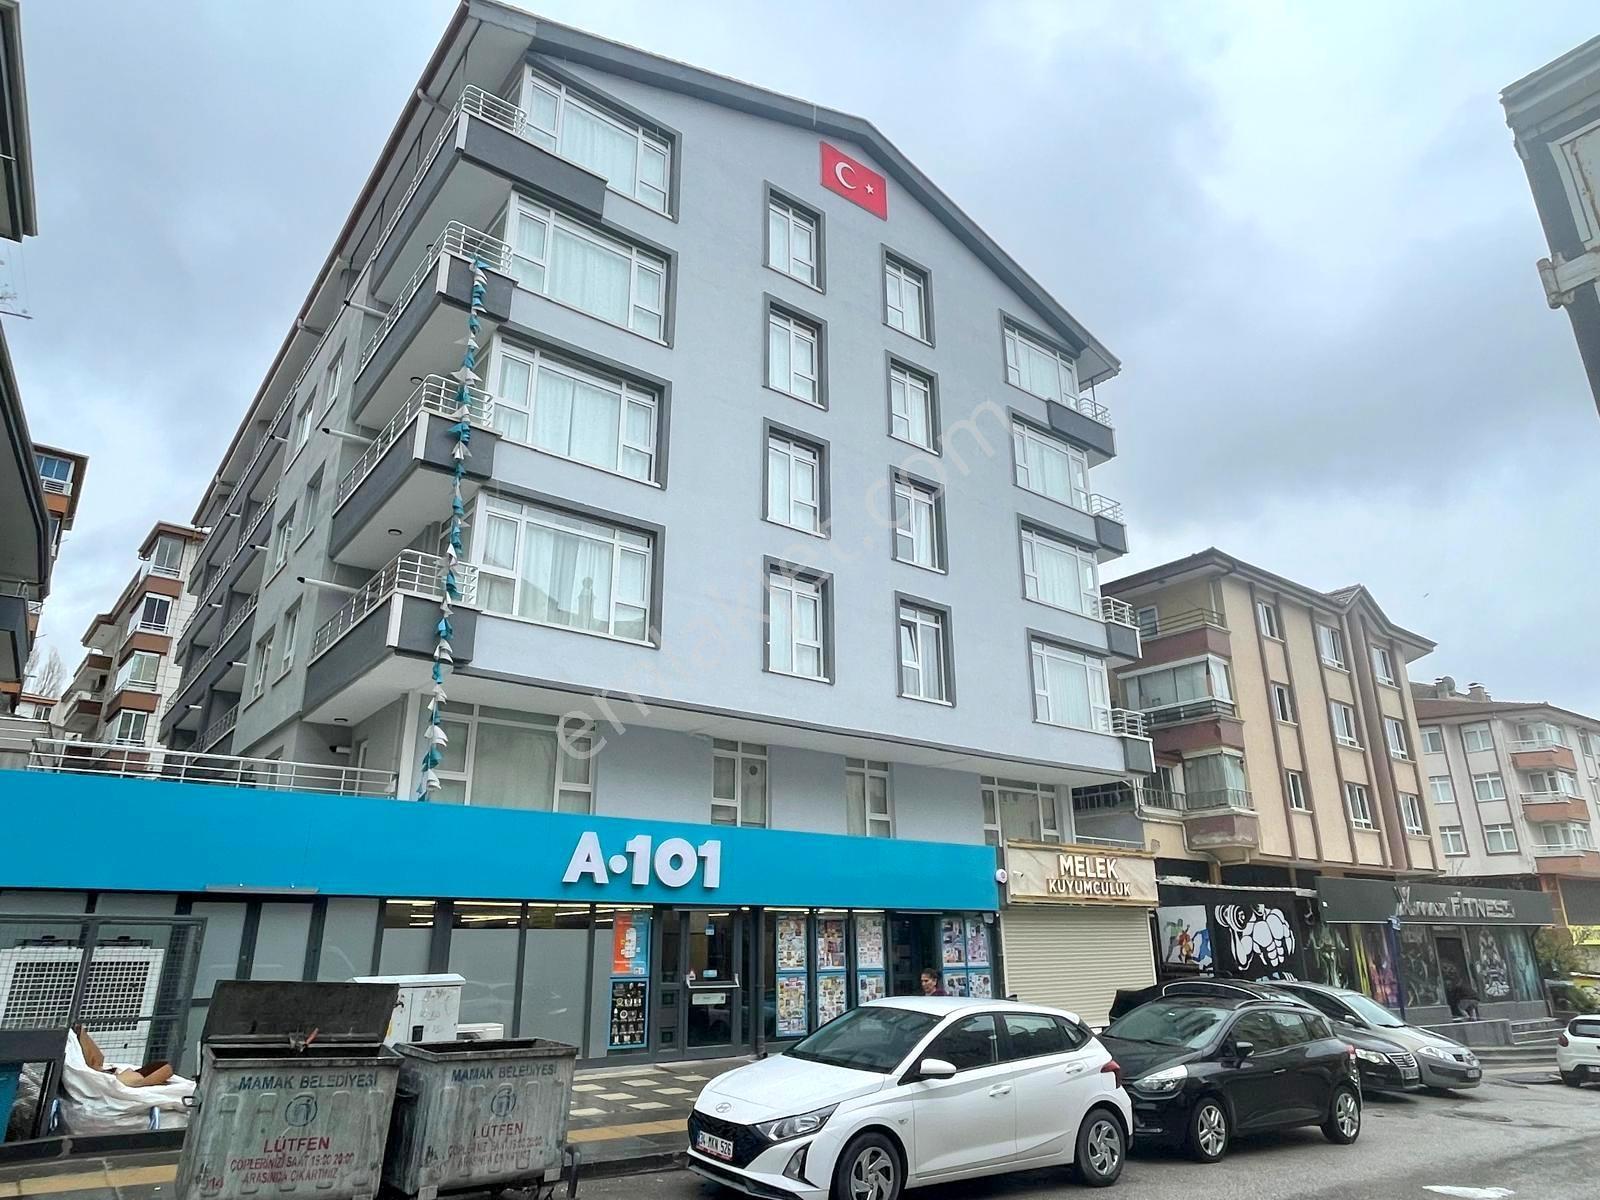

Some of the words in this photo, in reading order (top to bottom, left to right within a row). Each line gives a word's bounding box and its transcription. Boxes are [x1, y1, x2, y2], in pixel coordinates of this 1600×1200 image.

[1058, 854, 1119, 879] MELEK
[1047, 879, 1131, 896] KUYUMCULUK
[239, 1076, 293, 1090] MAMAK
[451, 1068, 493, 1082] MAMAK
[264, 1136, 330, 1153] LÜTFEN
